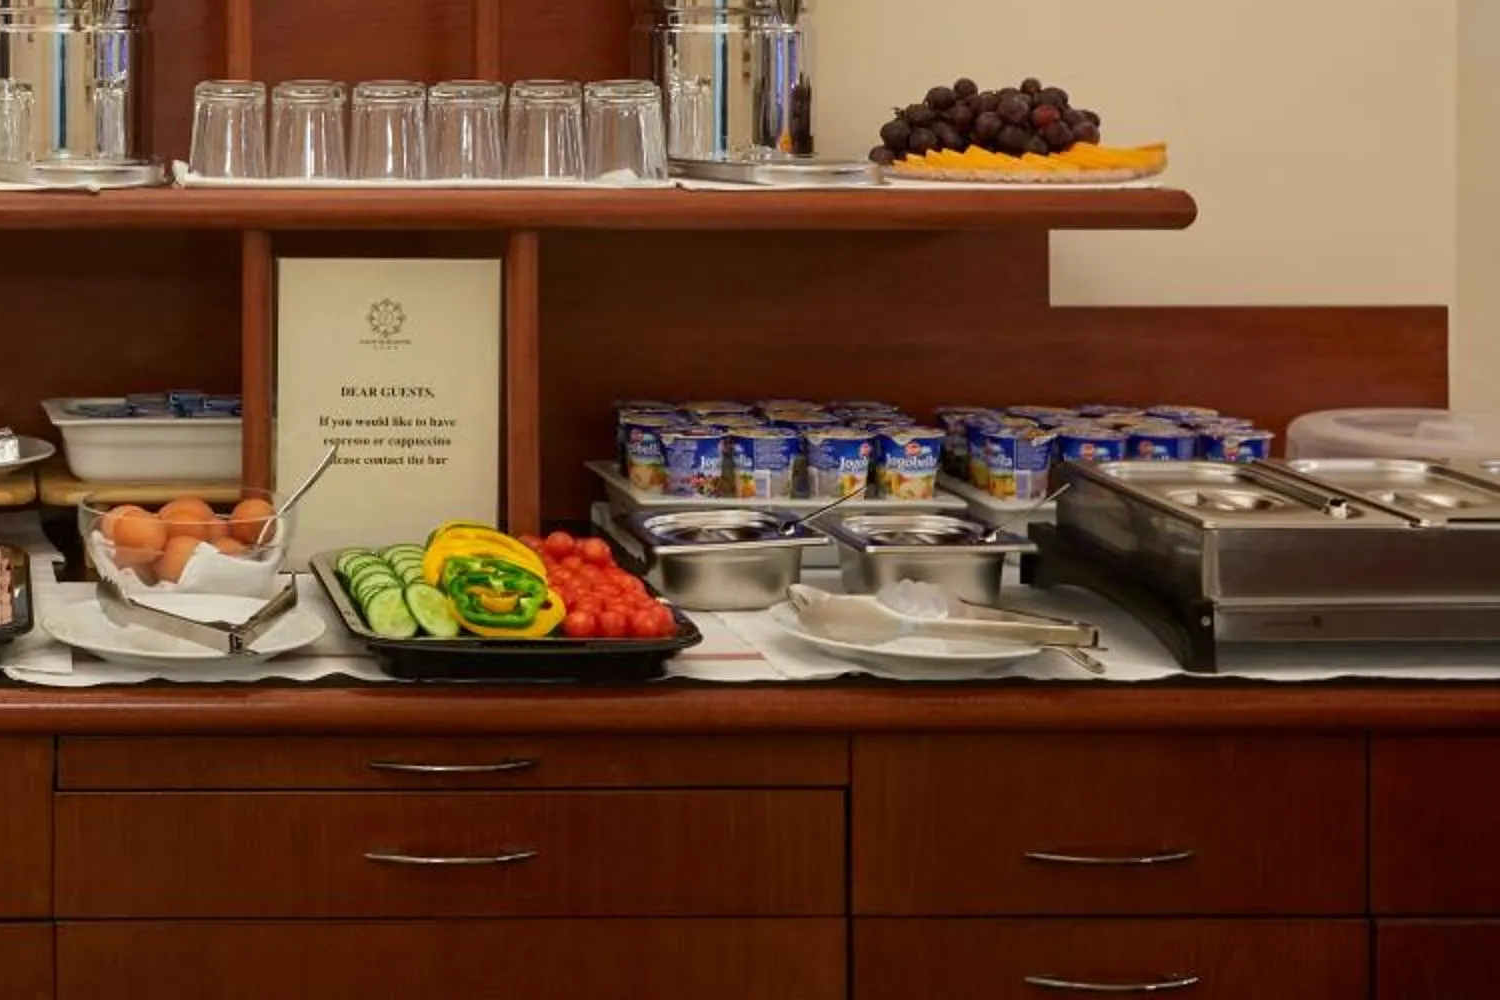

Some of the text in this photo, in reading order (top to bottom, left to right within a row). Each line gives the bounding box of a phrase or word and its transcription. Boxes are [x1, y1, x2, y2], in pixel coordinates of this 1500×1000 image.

[340, 386, 436, 399] DEAR GUESTS,
[319, 416, 456, 430] If you would like to have
[323, 436, 452, 449] espresso or cappuccino
[328, 455, 449, 466] lease contact the bar
